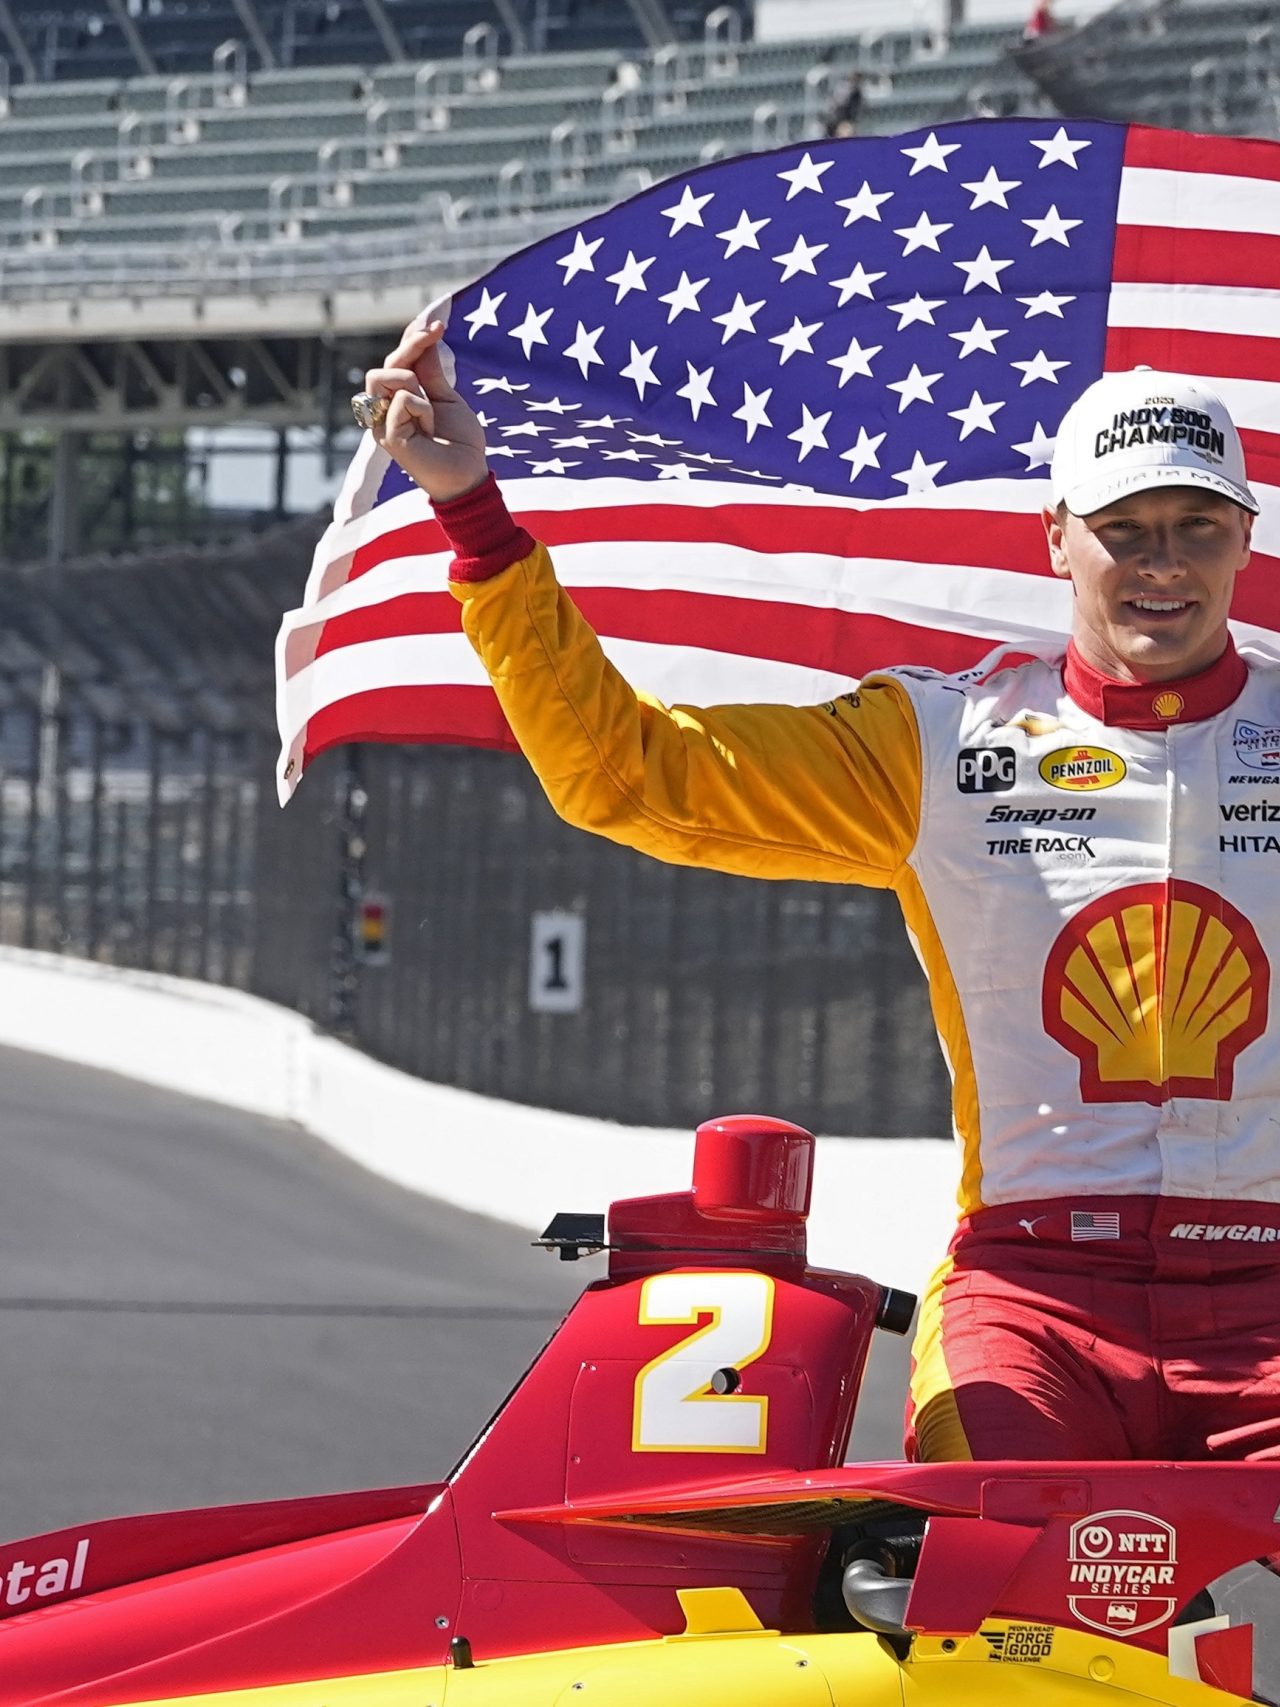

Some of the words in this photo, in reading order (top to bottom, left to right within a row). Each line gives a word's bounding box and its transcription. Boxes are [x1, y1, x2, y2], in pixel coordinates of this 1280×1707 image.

[1113, 407, 1167, 430] INDY
[1171, 407, 1212, 430] 500
[1095, 425, 1225, 459] CHAMPION
[959, 750, 1015, 791] PPG
[1050, 758, 1114, 780] PENNZOIL
[985, 804, 1097, 826] Snap-on
[544, 937, 569, 991] 1
[632, 1272, 775, 1454] 2
[1118, 1533, 1167, 1553] NTT
[0, 1538, 90, 1606] tal
[1069, 1564, 1175, 1585] INDYCAR
[1090, 1582, 1151, 1596] SERIES
[1006, 1632, 1055, 1645] FORCE
[1009, 1643, 1052, 1656] GOOD
[1002, 1655, 1042, 1663] CHALLENGE
